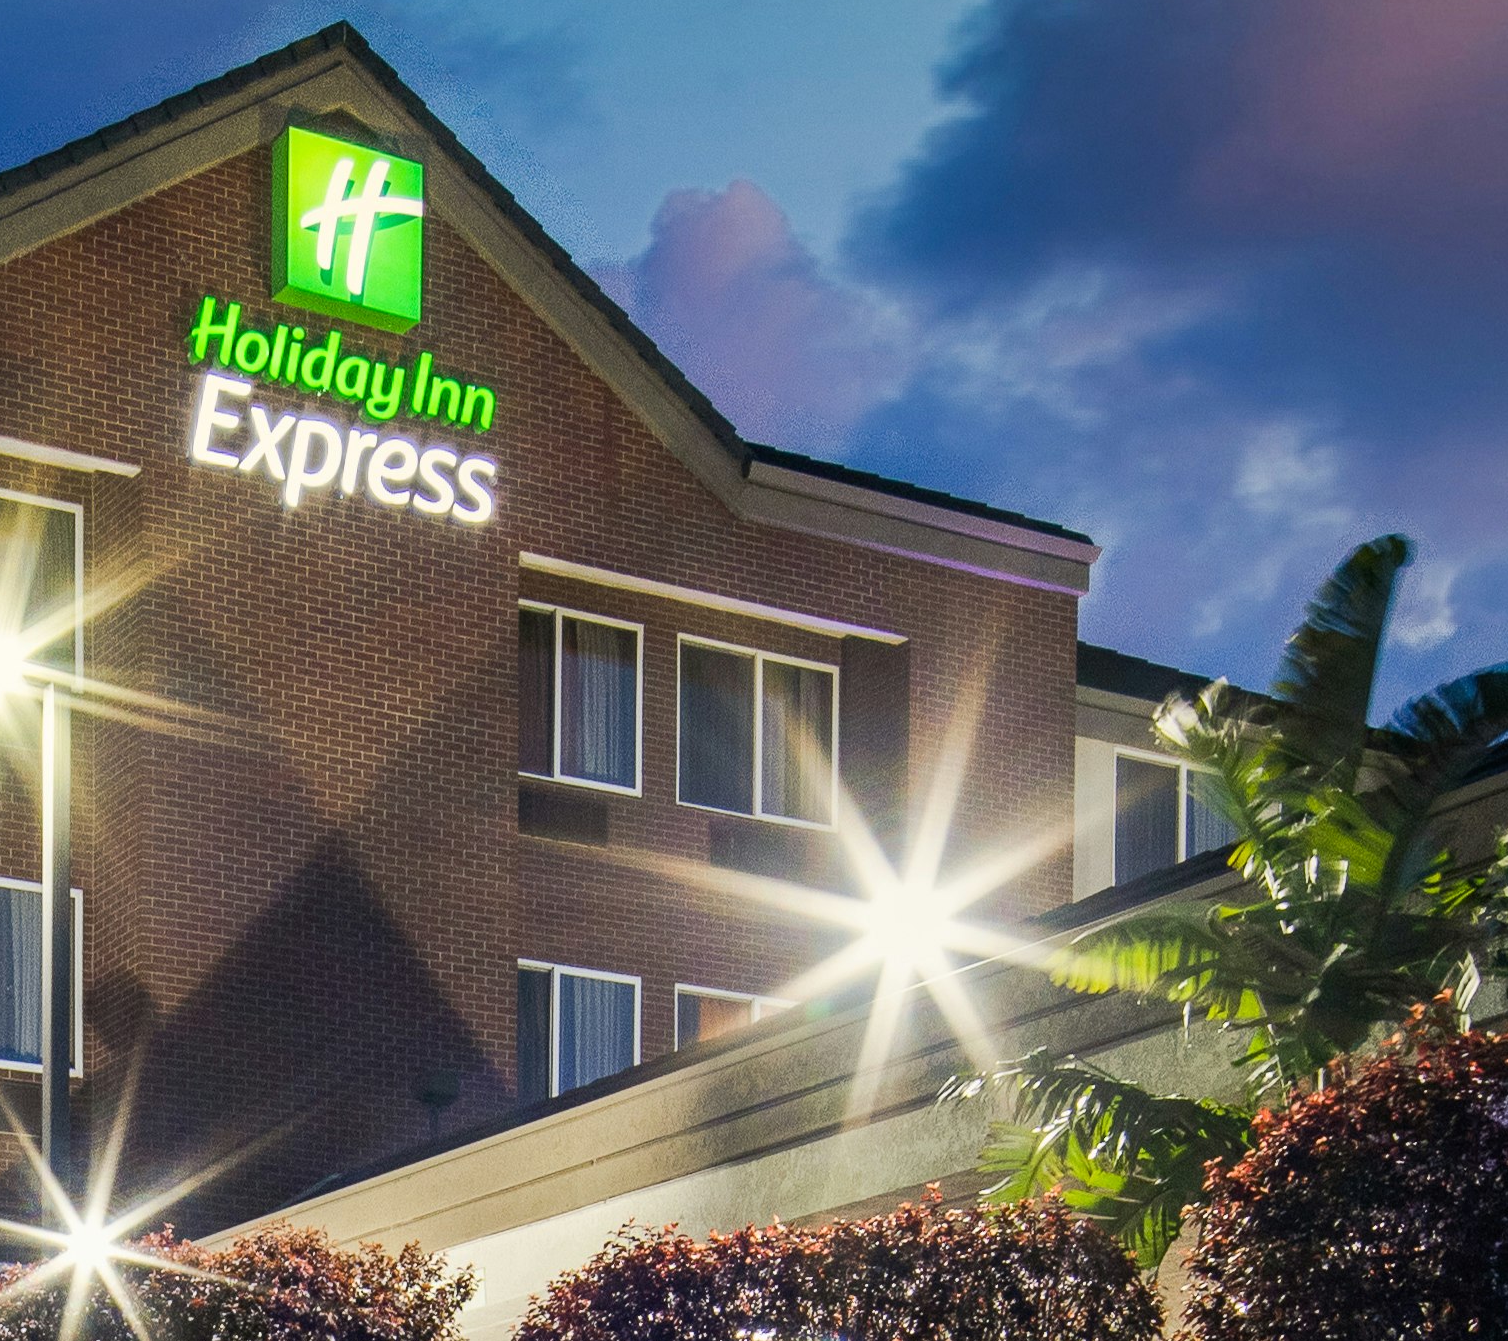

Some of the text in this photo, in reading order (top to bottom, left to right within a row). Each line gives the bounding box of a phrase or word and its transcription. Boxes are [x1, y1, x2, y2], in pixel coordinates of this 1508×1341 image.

[191, 295, 497, 432] Holiday Inn
[191, 371, 497, 523] Express
